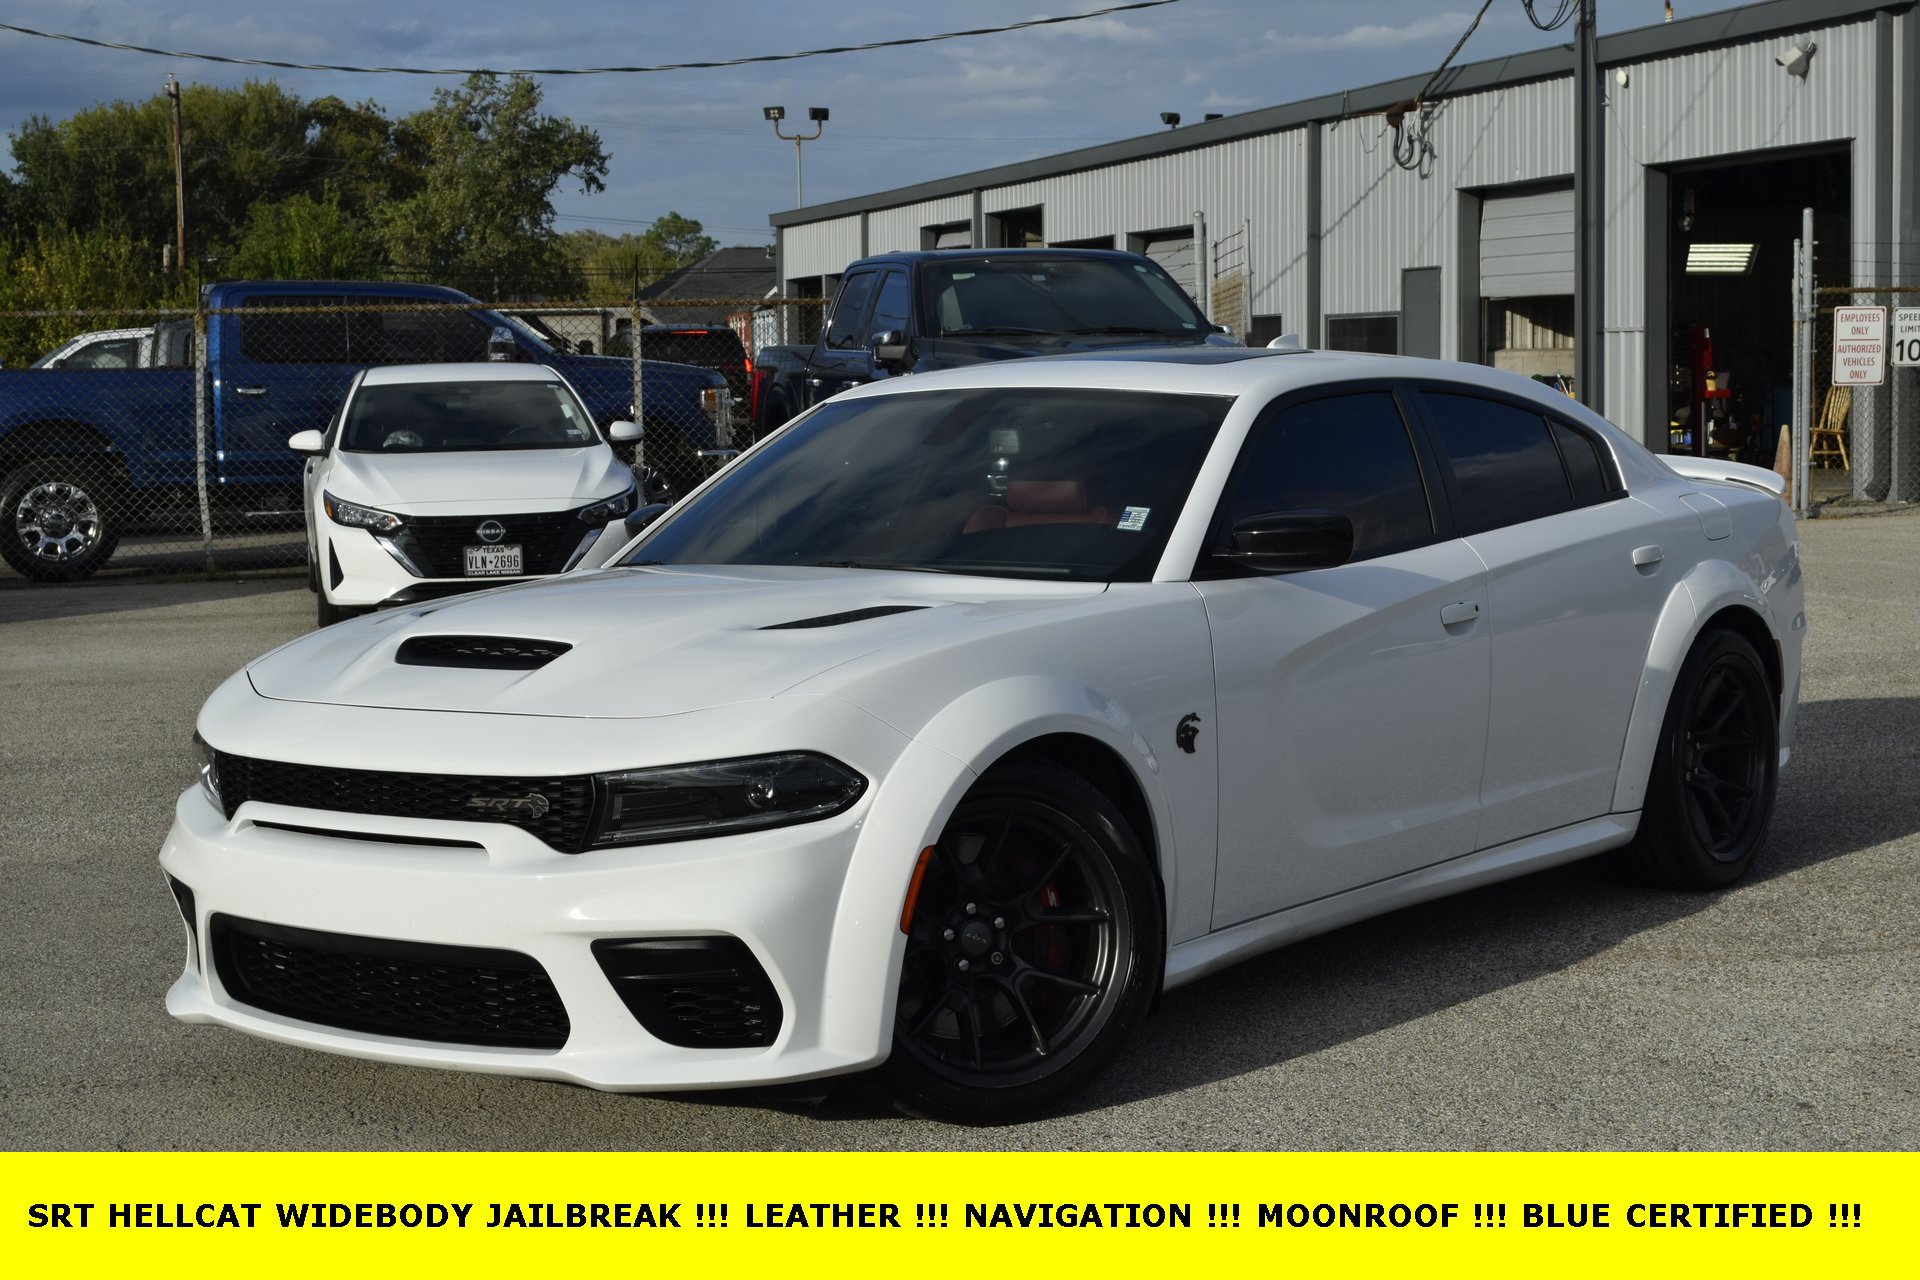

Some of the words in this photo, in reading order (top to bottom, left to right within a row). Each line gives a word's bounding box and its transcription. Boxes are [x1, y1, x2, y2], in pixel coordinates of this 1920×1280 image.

[1840, 313, 1880, 322] EMPLOYEES
[1851, 326, 1869, 335] ONLY
[1900, 325, 1920, 333] LIMIT
[1837, 344, 1881, 353] AUTHORIZED
[1895, 338, 1920, 361] 10
[1842, 357, 1875, 366] VEHICLES
[1849, 370, 1868, 379] ONLY
[466, 798, 531, 811] SRT
